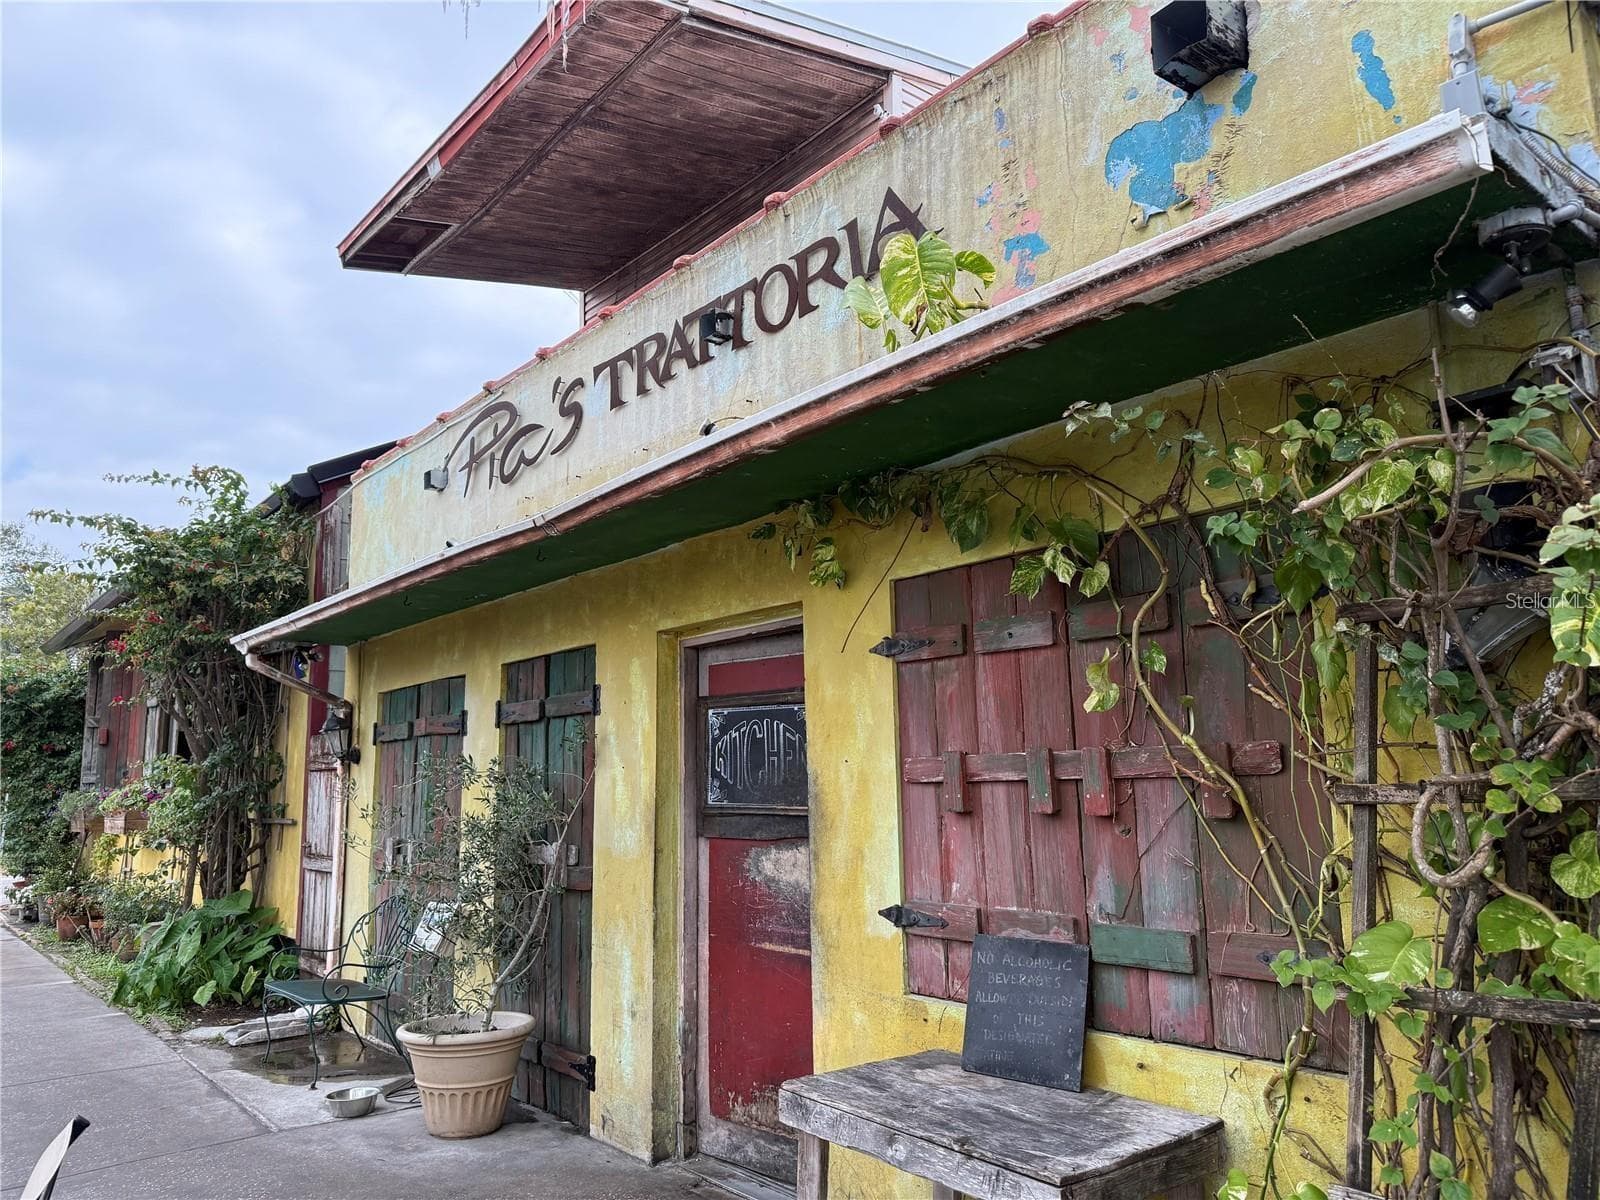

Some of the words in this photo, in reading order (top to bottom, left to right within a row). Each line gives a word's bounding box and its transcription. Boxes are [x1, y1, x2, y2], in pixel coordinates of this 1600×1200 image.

[444, 376, 585, 498] Pia's
[594, 186, 944, 411] TRATTORIA
[976, 951, 995, 966] NO
[1002, 956, 1073, 971] ALCOHOLIC
[987, 972, 1062, 989] BEVERAGES
[1016, 1012, 1045, 1027] THIS
